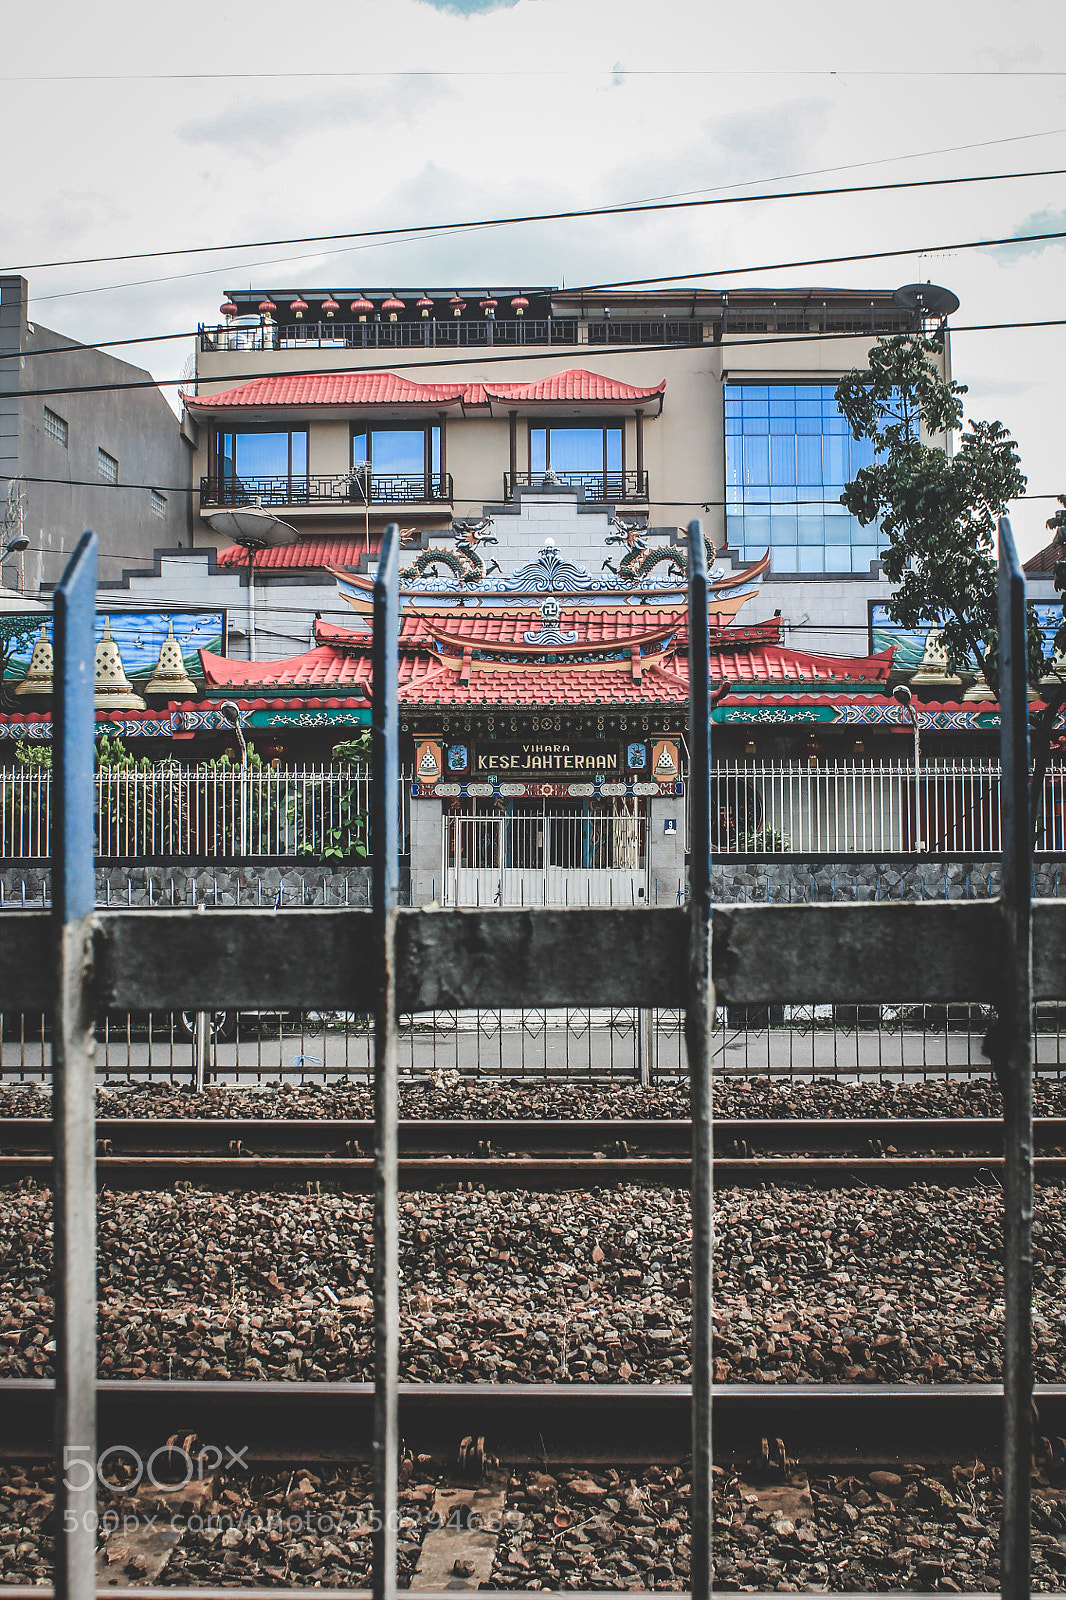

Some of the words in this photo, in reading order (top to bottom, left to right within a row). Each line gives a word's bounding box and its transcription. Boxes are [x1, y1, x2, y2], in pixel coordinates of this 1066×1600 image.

[522, 744, 570, 753] VIHARA
[478, 755, 617, 769] KESEJAHTERAAN
[667, 820, 674, 829] 9
